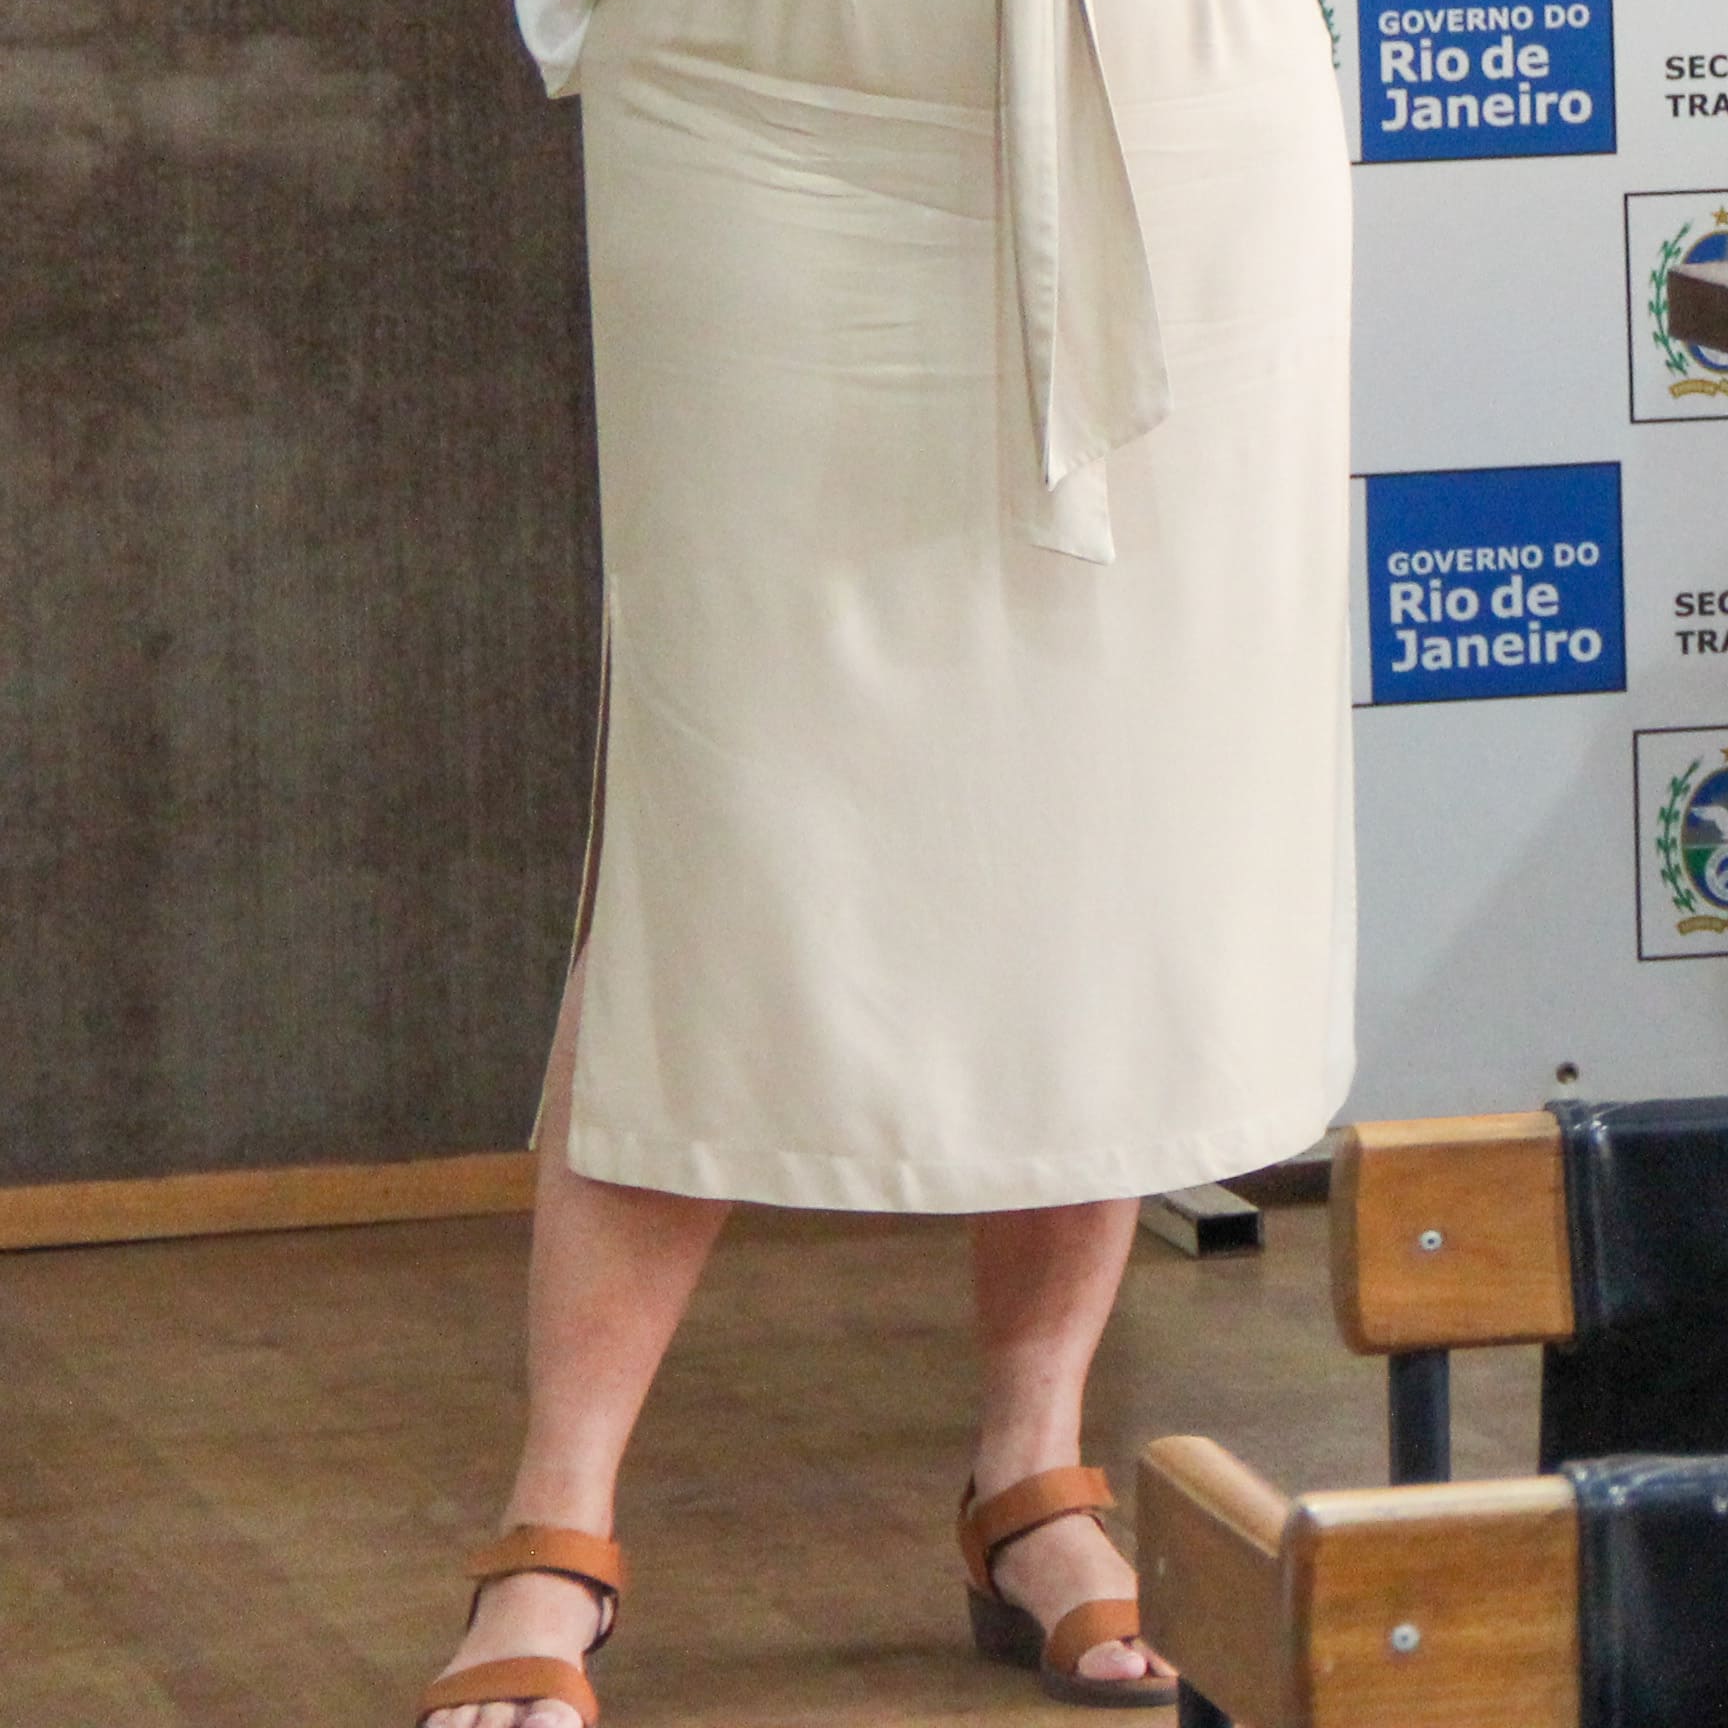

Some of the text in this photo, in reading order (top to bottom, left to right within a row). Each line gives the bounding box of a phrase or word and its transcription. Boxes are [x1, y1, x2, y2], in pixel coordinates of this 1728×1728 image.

[1378, 4, 1590, 35] GOVERNO DO
[1380, 35, 1549, 83] Rio de
[1382, 81, 1592, 131] Janeiro
[1388, 542, 1600, 577] GOVERNO DO
[1390, 574, 1559, 624] Rio de
[1392, 621, 1602, 672] Janeiro
